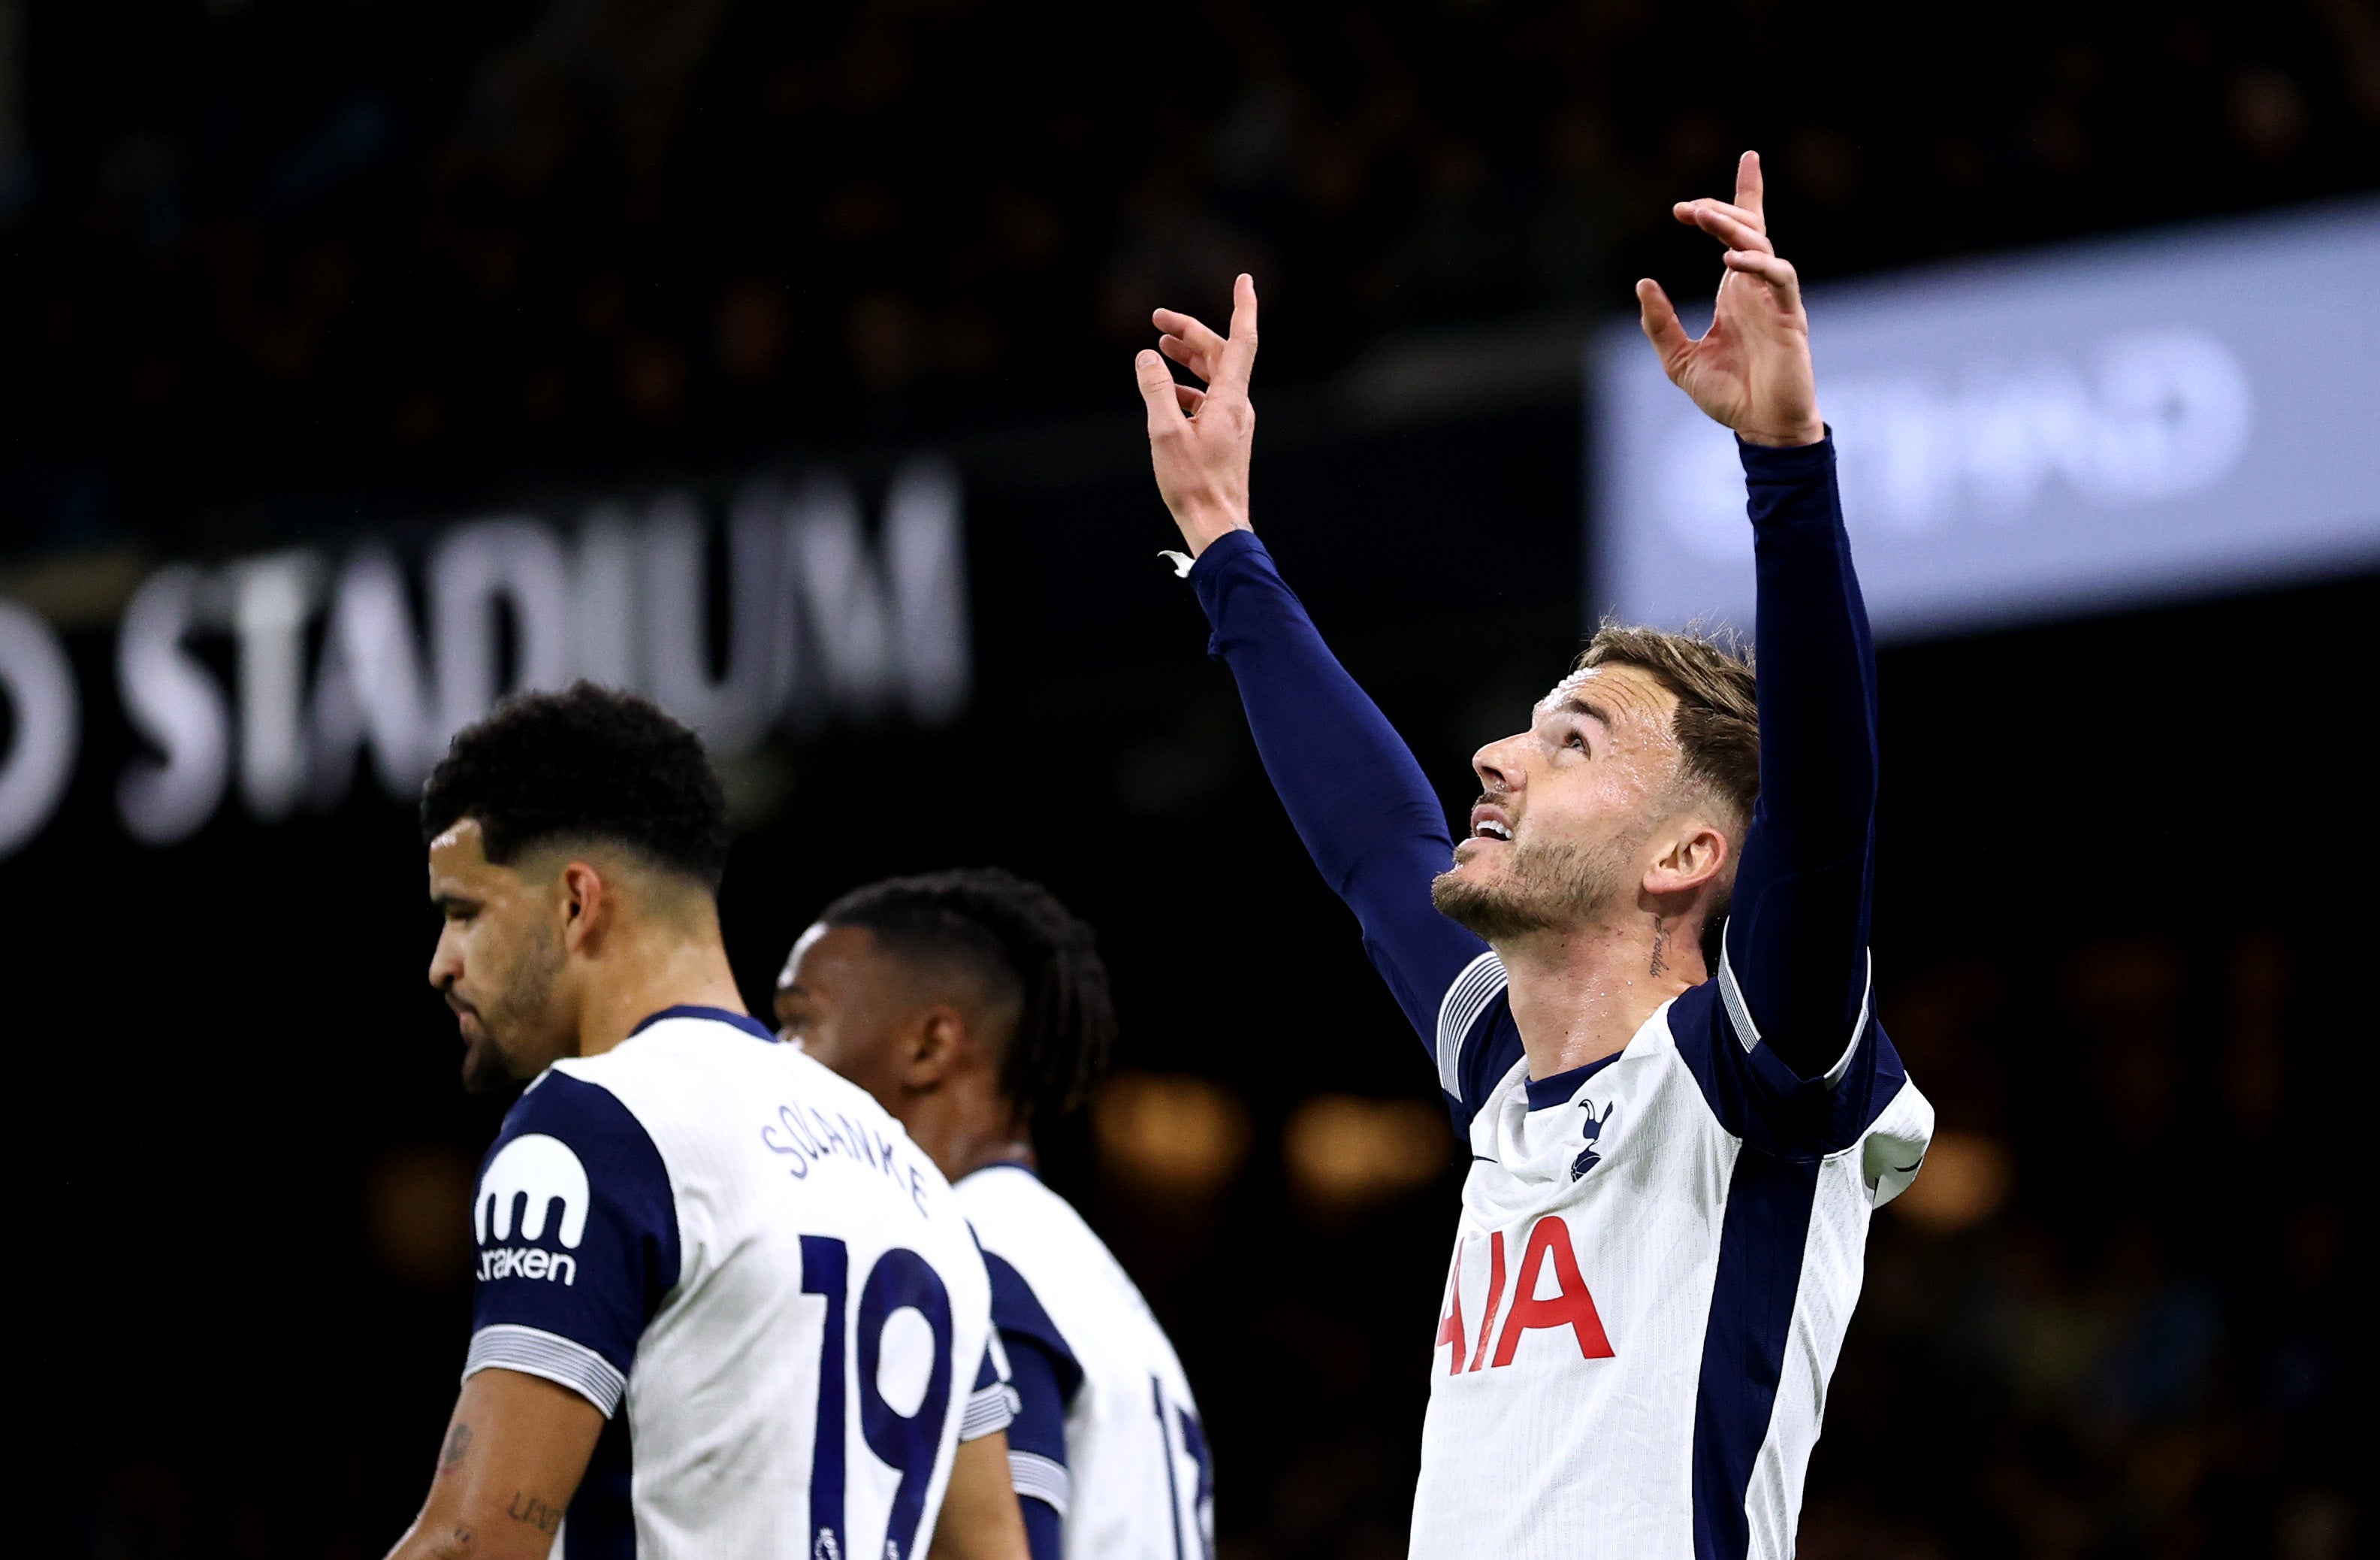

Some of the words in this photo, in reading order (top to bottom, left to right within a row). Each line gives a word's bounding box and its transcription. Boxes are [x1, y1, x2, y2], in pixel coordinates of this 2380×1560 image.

[114, 460, 969, 843] STADIUM
[760, 1099, 929, 1220] SOLANKE
[476, 1247, 576, 1286] raken
[1435, 1214, 1615, 1377] AIA
[798, 1234, 953, 1560] 19
